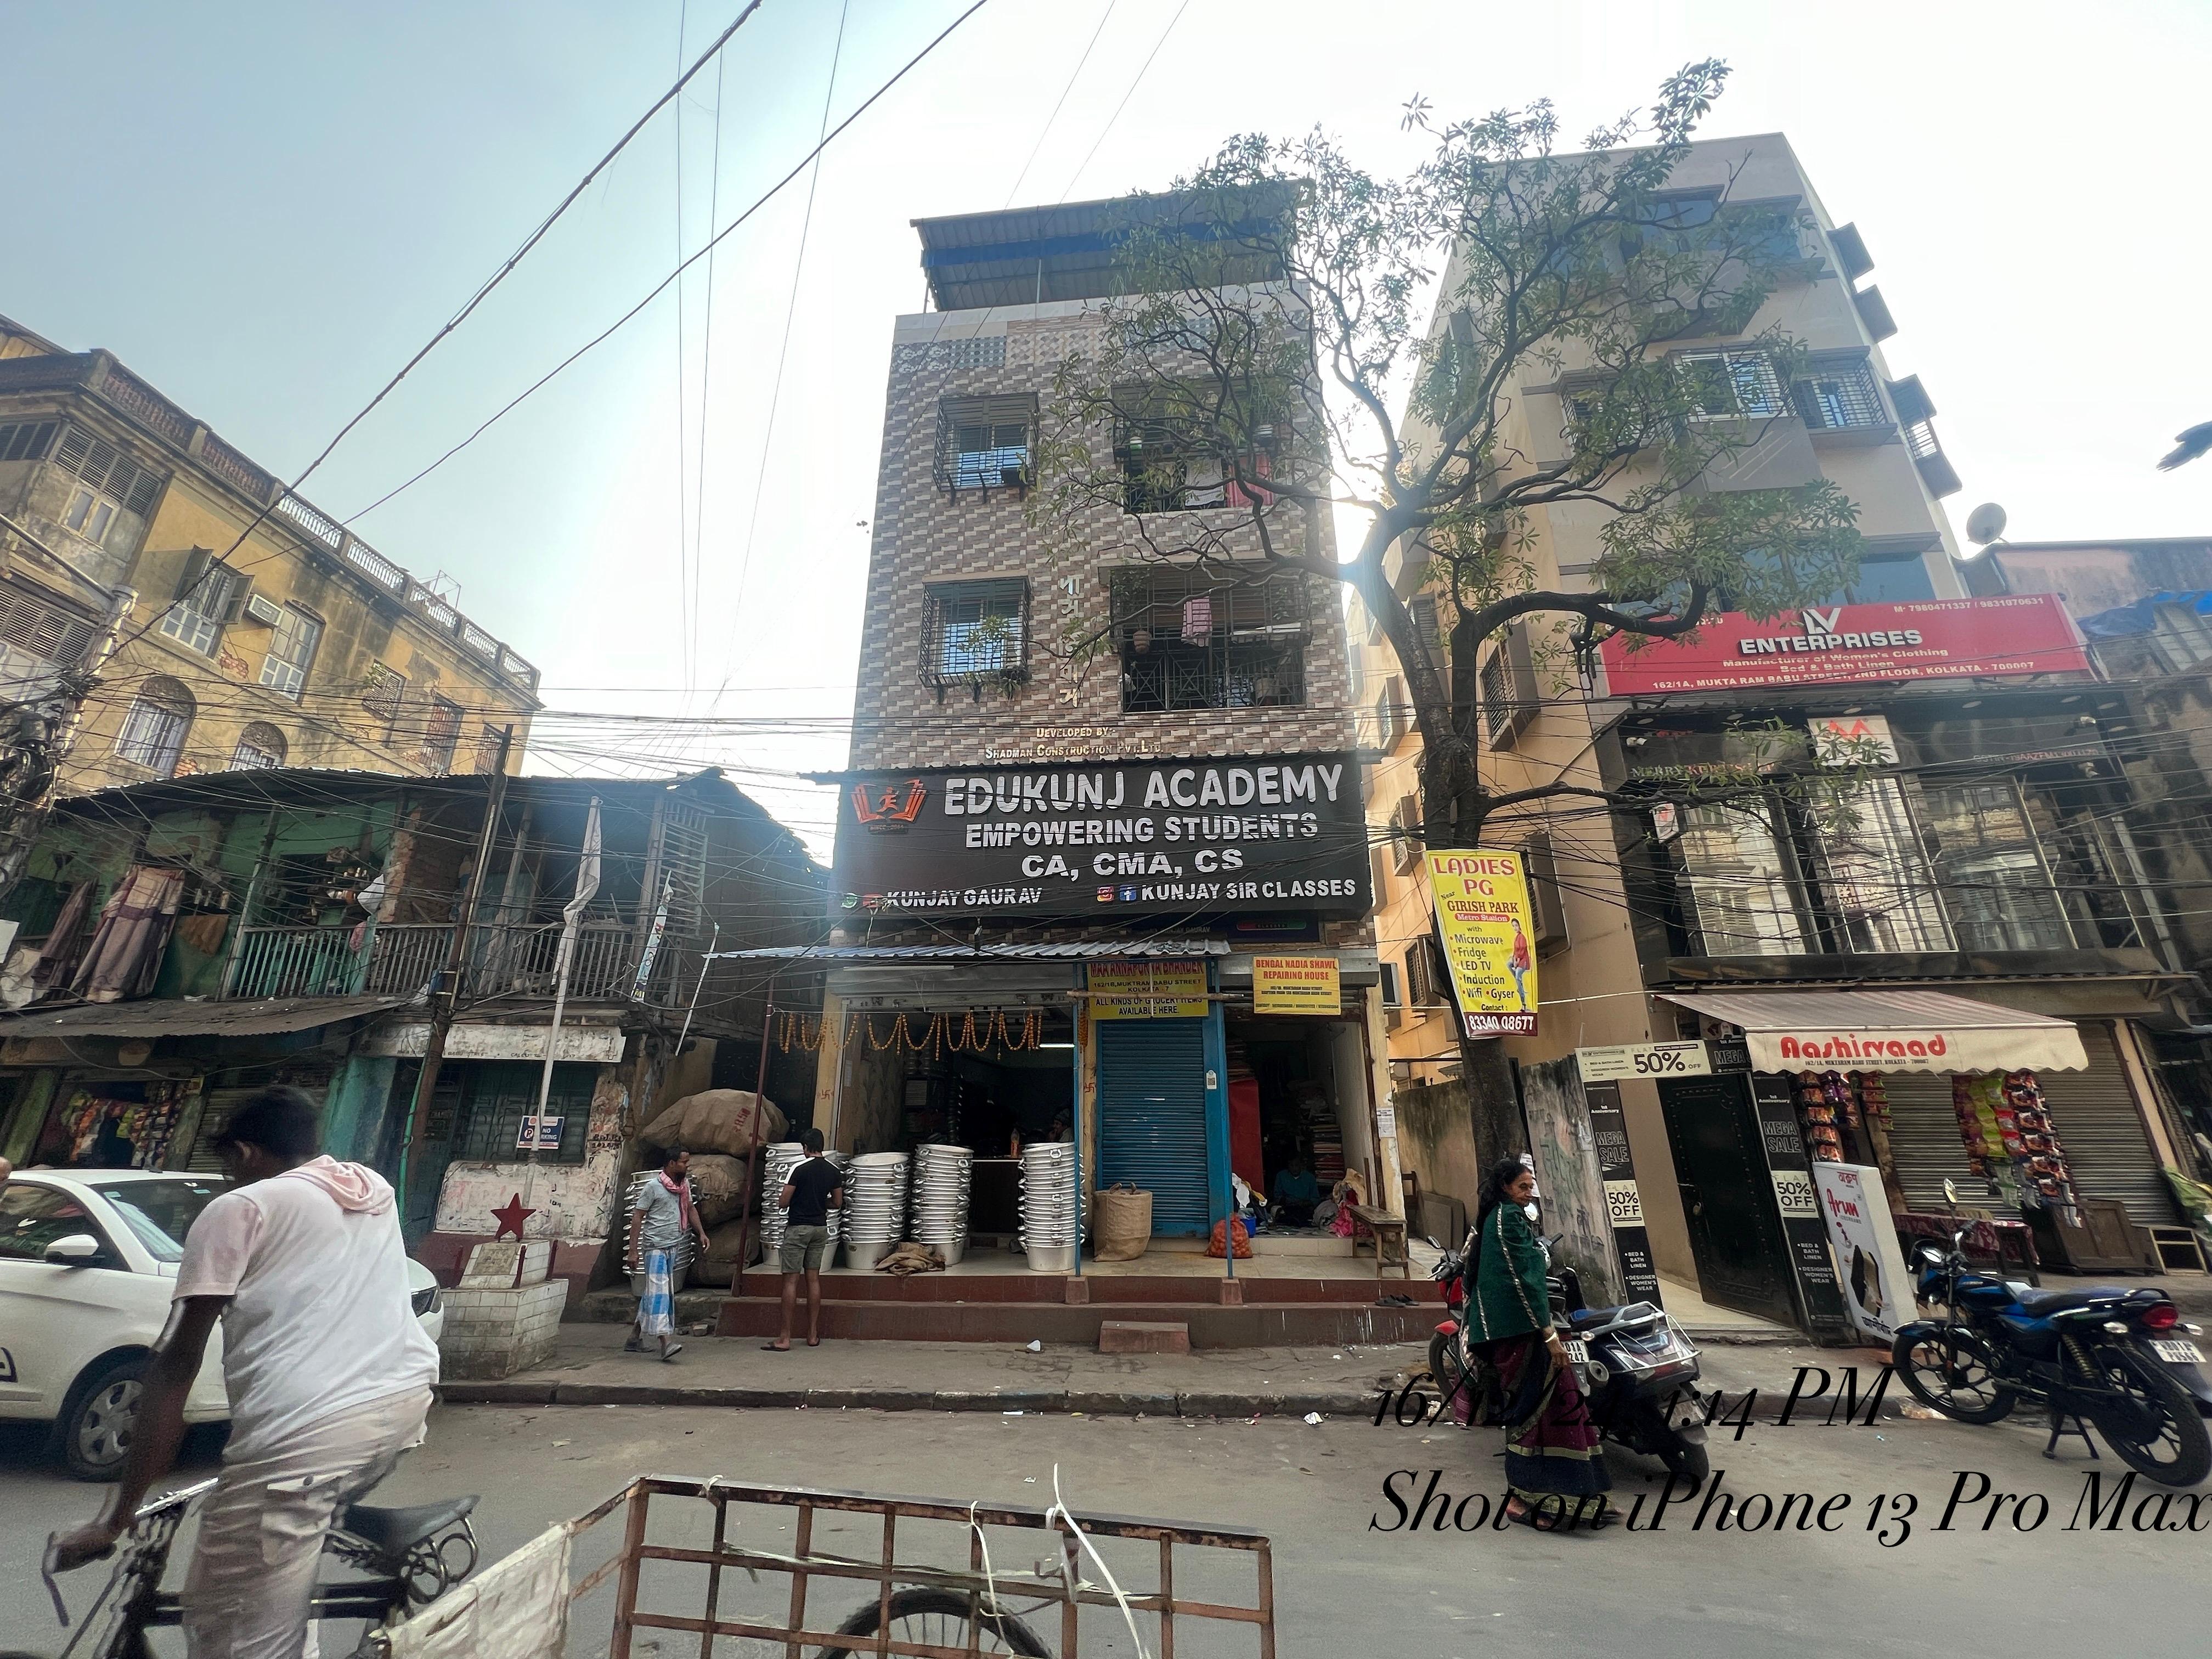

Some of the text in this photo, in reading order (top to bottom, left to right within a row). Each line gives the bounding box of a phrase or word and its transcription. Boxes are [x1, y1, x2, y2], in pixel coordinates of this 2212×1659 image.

[1740, 629, 1923, 654] ENTERPRISES
[1723, 657, 1809, 667] Manufacturer
[1830, 652, 1888, 662] Women's
[1893, 648, 1949, 658] Clothing
[1696, 677, 1737, 686] MUKTA
[1739, 675, 1765, 684] RAM
[1768, 674, 1800, 682] BABU
[1854, 670, 1877, 678] 2ND
[1879, 667, 1924, 677] FLOOR,
[1926, 664, 1982, 674] KOLKATA
[1990, 661, 2035, 671] 700007
[1780, 664, 1805, 673] Bed
[1824, 662, 1854, 670] Bath
[1858, 660, 1895, 668] Linen
[944, 763, 1342, 816] EDUKUNJ ACADEMY
[966, 812, 1318, 848] EMPOWERING STUDENTS
[1022, 848, 1244, 882] CA, CMA, CS
[1434, 857, 1515, 876] LADIES
[1141, 878, 1356, 901] KUNJAY SIR CLASSES
[1463, 879, 1494, 896] PG
[887, 887, 1043, 907] KUNJAY GAURAV
[1441, 891, 1455, 900] Near
[1447, 900, 1520, 913] GIRISH PARK
[1481, 914, 1508, 922] Station
[1455, 934, 1503, 945] Microwave
[1458, 947, 1487, 958] Fridge
[1256, 960, 1338, 969] BENGAL NADIA SHAWL
[1460, 961, 1491, 971] LED TV
[1263, 970, 1329, 980] REPAIRING HOUSE
[1464, 974, 1505, 985] Induction
[1466, 988, 1515, 1001] Wifi Gyser
[1481, 1003, 1504, 1012] Contact
[1468, 1015, 1499, 1031] 83340
[1780, 1034, 1947, 1058] Aashirvaad
[1633, 1052, 1686, 1074] 50%
[1763, 1121, 1797, 1136] MEGA
[1595, 1131, 1626, 1146] MEGA
[1767, 1137, 1801, 1153] SALE
[1599, 1147, 1630, 1163] SALE
[1776, 1182, 1812, 1195] 50%
[1608, 1191, 1639, 1205] 50%
[1781, 1196, 1813, 1207] OFF
[1826, 1188, 1860, 1218] Arun
[1611, 1205, 1640, 1216] OFF
